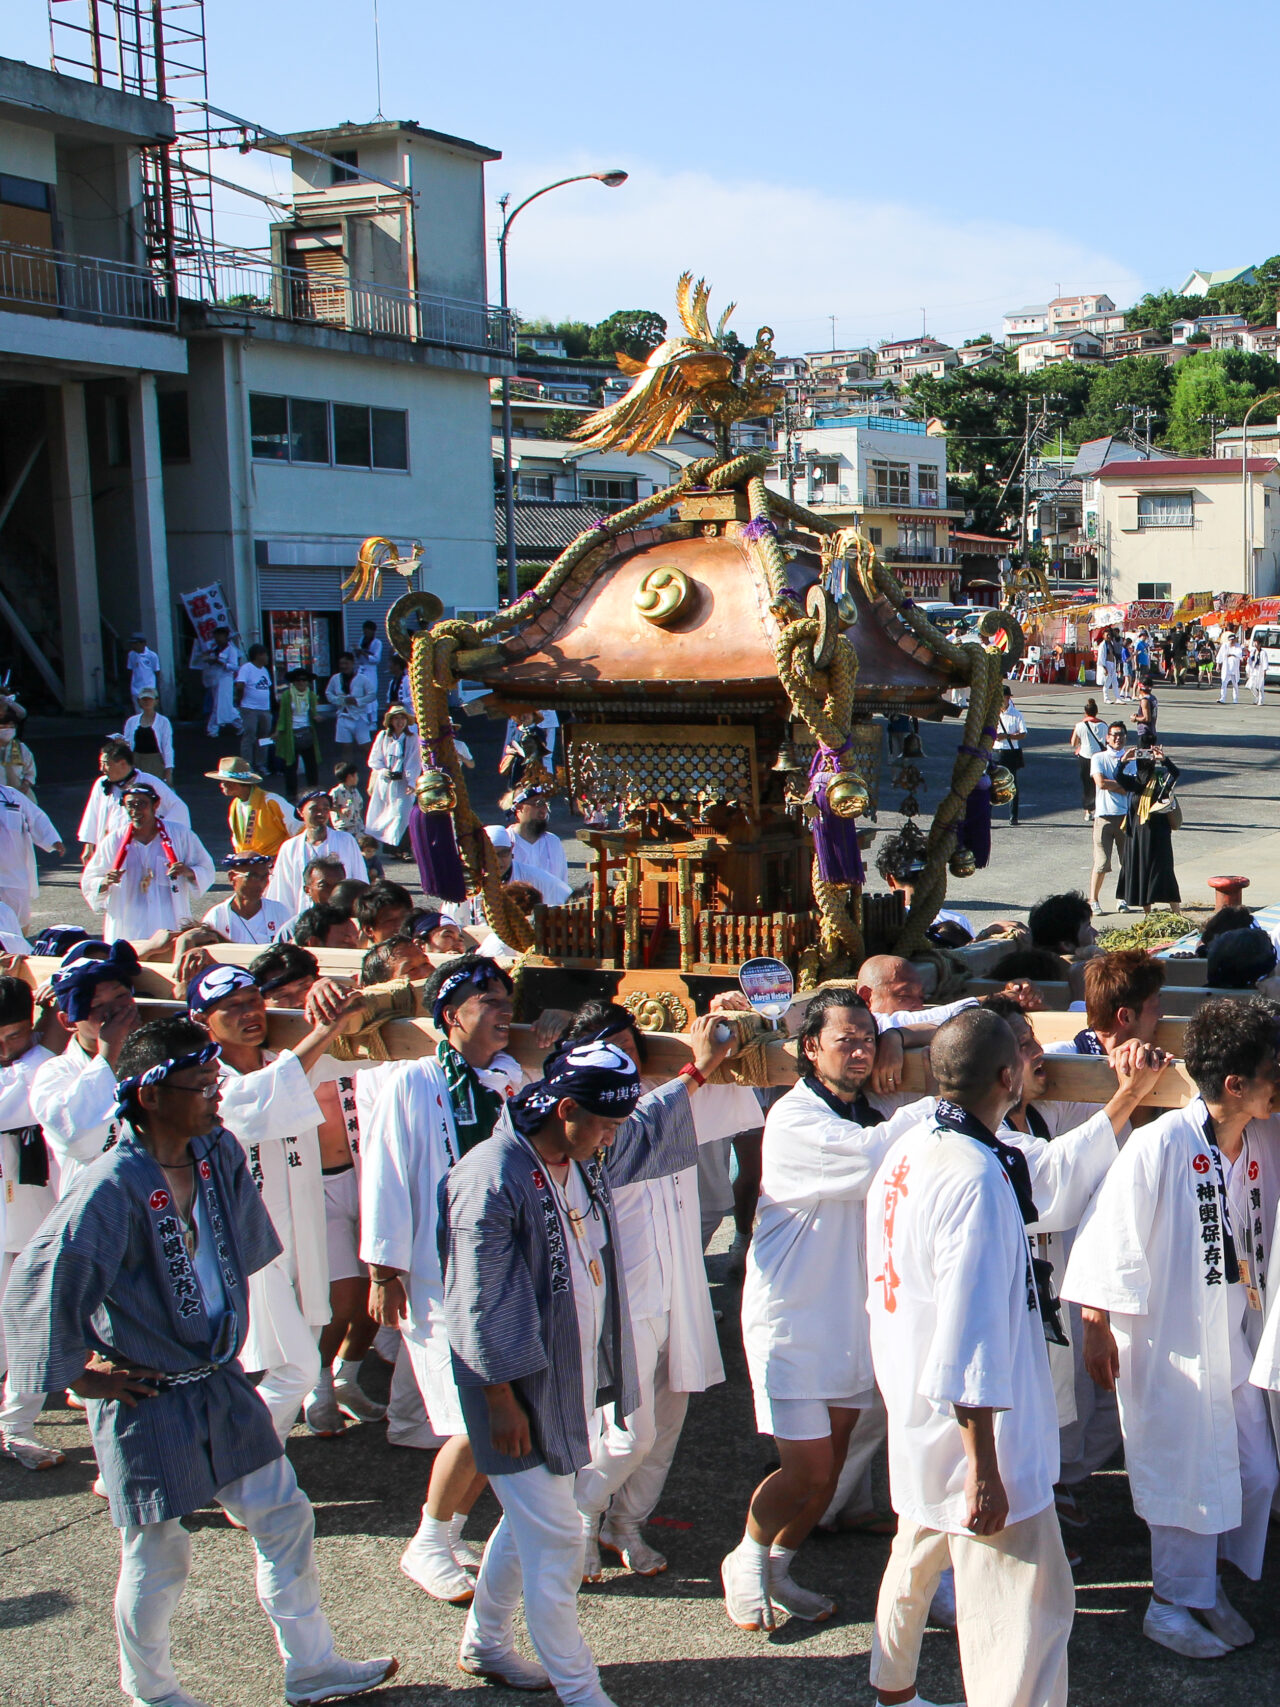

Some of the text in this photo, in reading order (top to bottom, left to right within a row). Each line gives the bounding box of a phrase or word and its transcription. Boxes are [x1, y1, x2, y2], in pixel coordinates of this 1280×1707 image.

[157, 1216, 200, 1318] 神輿保存会
[540, 1196, 568, 1294] 神輿保存会
[1196, 1181, 1223, 1286] 神輿保存会
